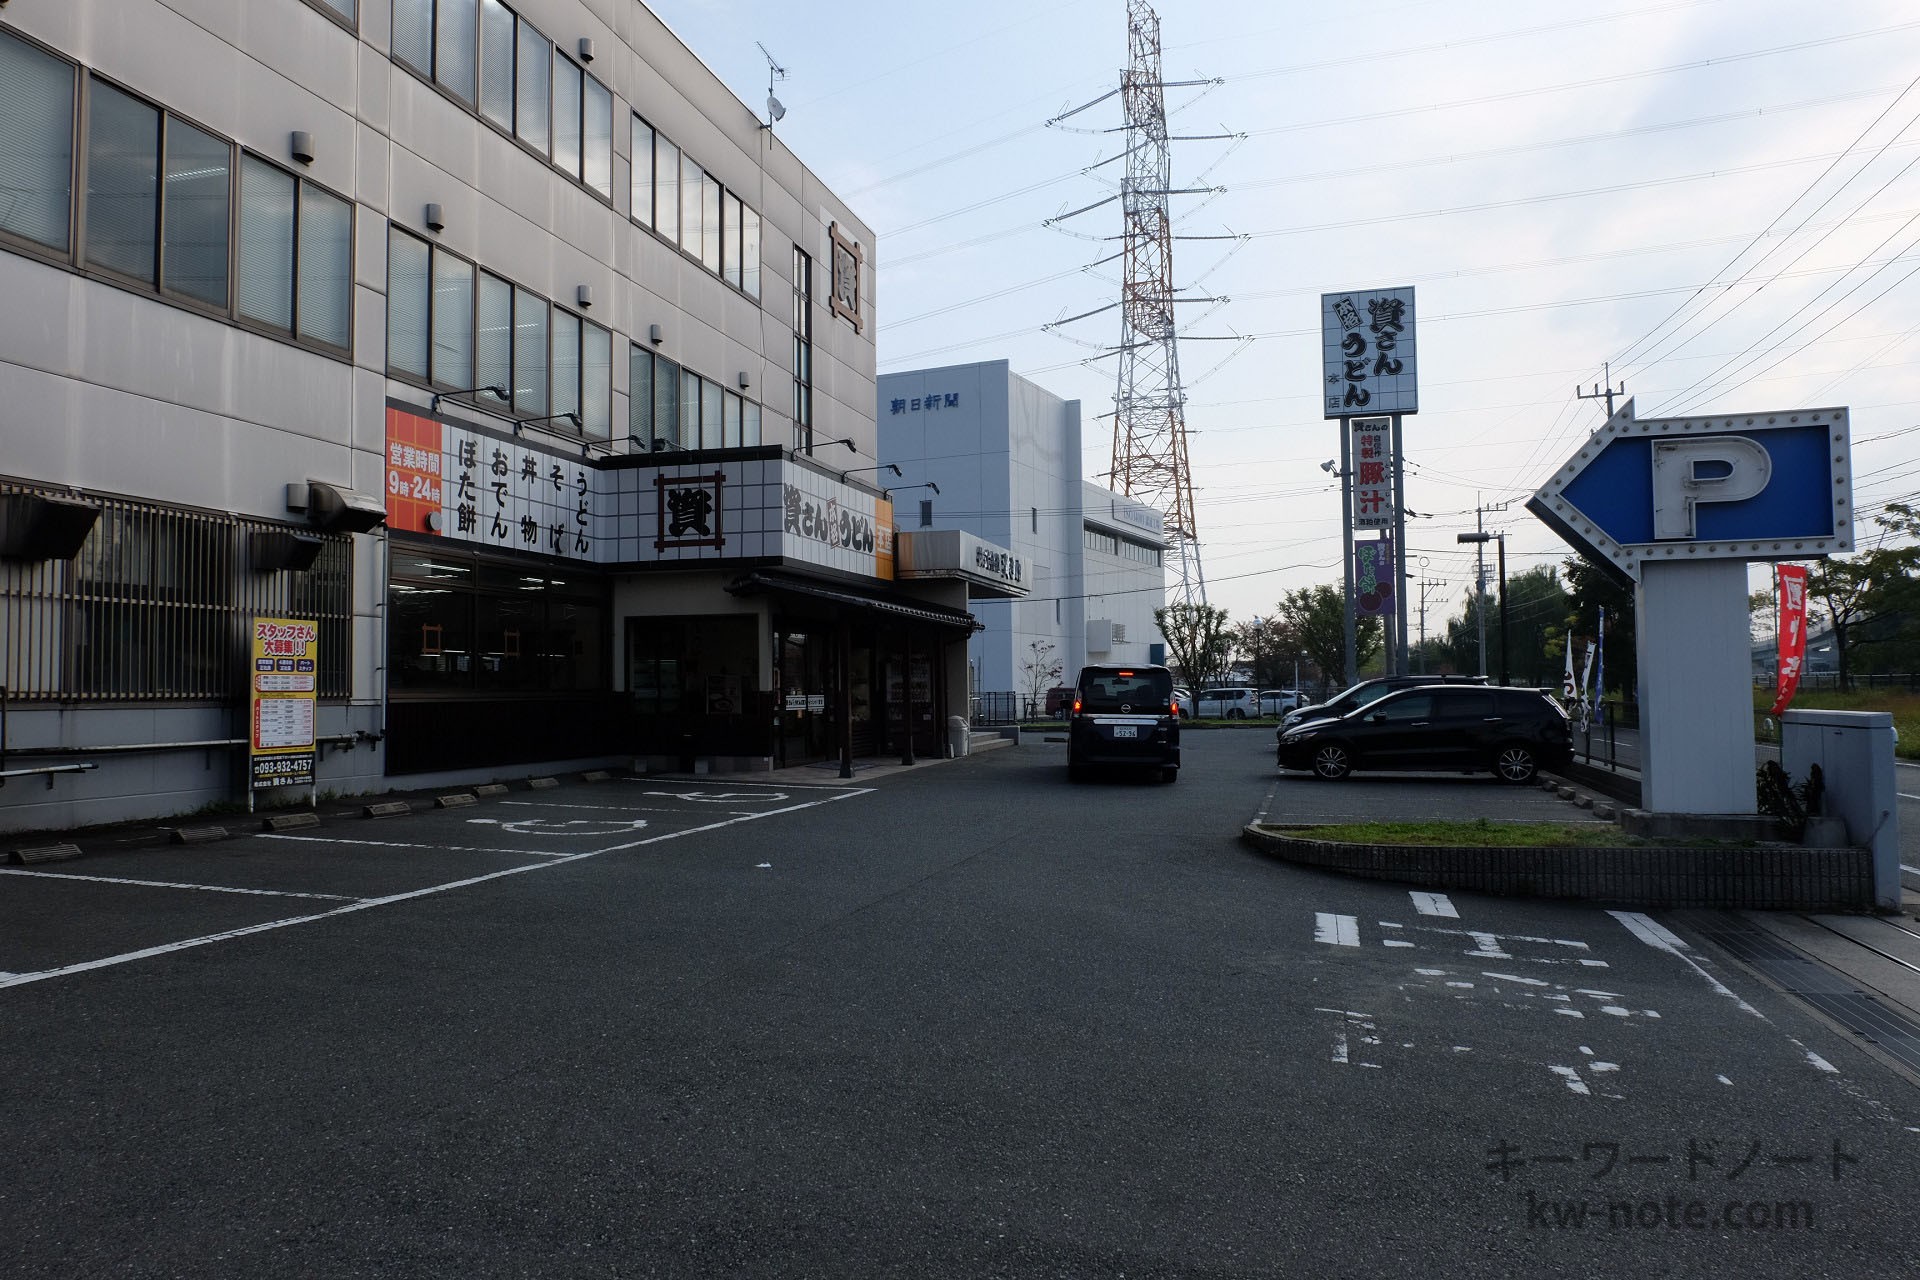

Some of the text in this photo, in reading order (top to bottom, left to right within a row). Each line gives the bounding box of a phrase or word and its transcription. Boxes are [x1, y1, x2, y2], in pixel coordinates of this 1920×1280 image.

[1341, 332, 1371, 407] うどん
[1368, 297, 1405, 376] 資さん
[890, 393, 959, 415] 朝日新聞
[1328, 373, 1340, 408] 本店
[390, 443, 440, 476] 営業時間
[458, 440, 477, 535] ぼた餅
[491, 449, 508, 539] おでん
[1360, 462, 1385, 513] 豚汁
[1651, 435, 1771, 539] P
[521, 455, 537, 544] 丼物
[550, 465, 564, 554] そば
[575, 472, 588, 554] うどん
[667, 487, 712, 537] 資
[783, 482, 827, 541] 資さん
[840, 510, 873, 553] うどん
[257, 623, 315, 640] スタッフさん
[260, 760, 312, 774] 093-932-4757
